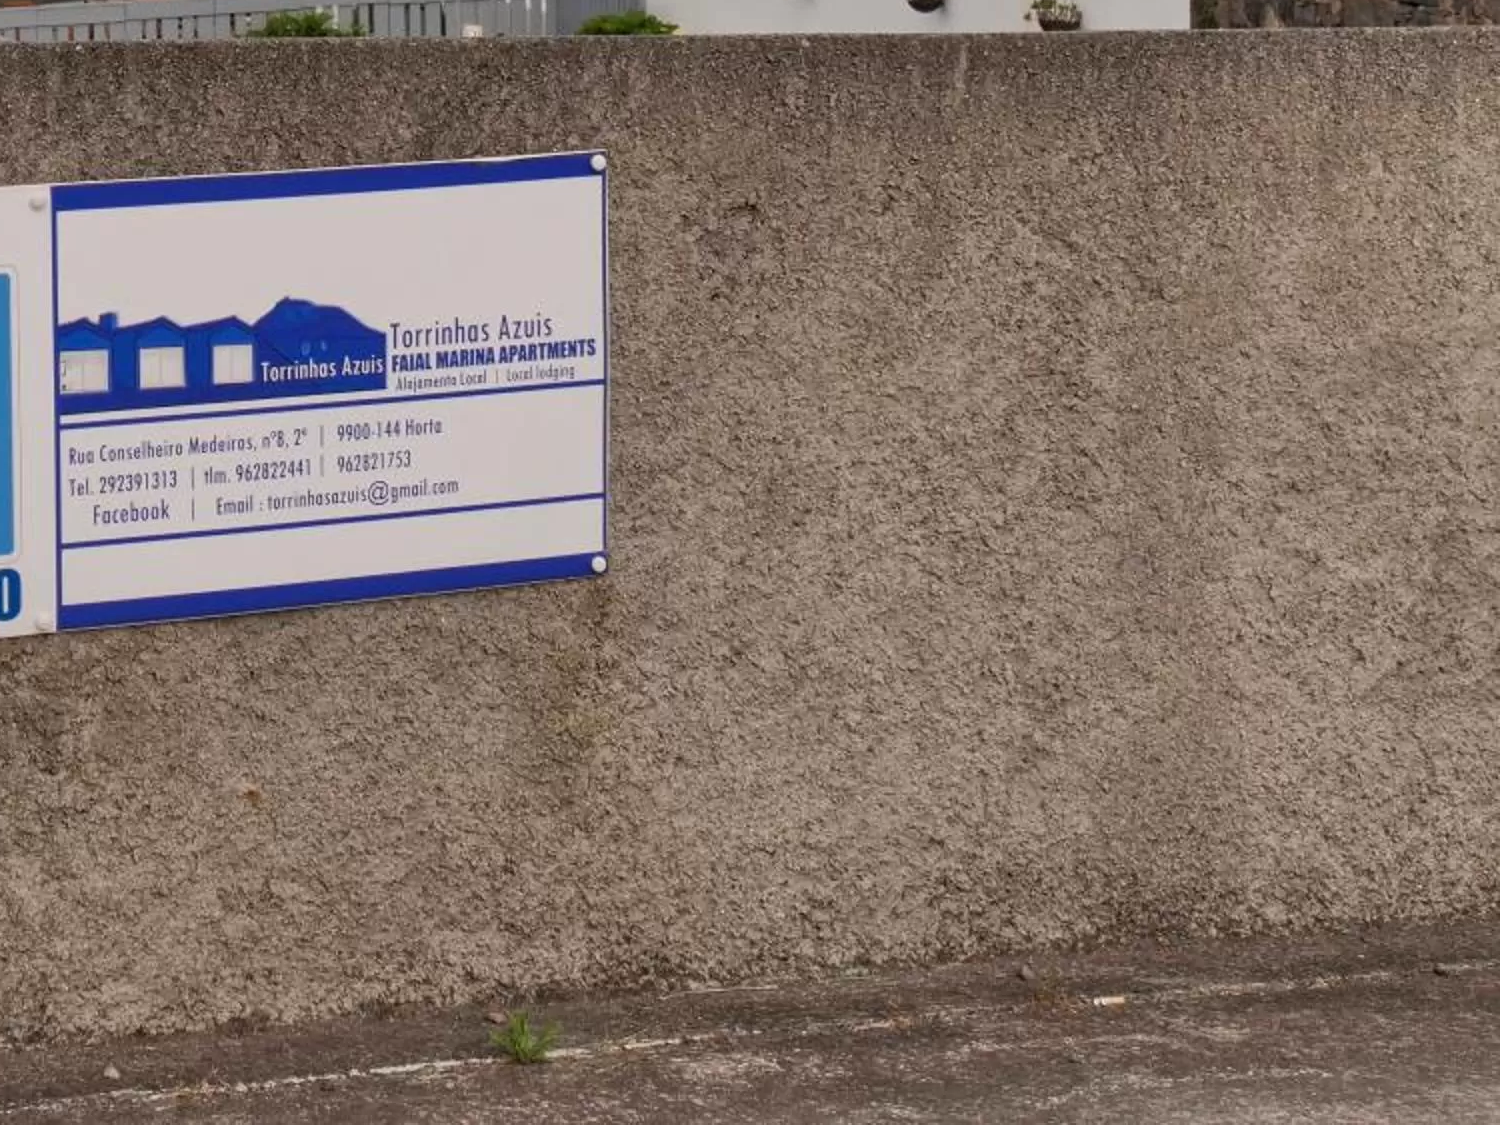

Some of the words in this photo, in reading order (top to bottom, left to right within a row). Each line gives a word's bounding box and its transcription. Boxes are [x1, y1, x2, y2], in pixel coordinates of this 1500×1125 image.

[389, 316, 489, 350] Torrinhas
[499, 312, 554, 341] Azuis
[260, 357, 336, 383] Torrinhas
[341, 353, 386, 378] Azuis
[391, 351, 433, 374] FAIAL
[436, 346, 496, 370] MARINA
[499, 338, 597, 365] APARTMENTS
[459, 370, 487, 386] Local
[507, 365, 533, 382] Local
[68, 447, 95, 466] Rua
[99, 440, 184, 463] Conselheiro
[187, 434, 258, 456] Medeiros,
[336, 420, 401, 442] 9900-144
[405, 418, 443, 437] Horta
[68, 477, 95, 496] Tel.
[99, 470, 178, 495] 292391313
[235, 459, 312, 483] 962822441
[336, 450, 412, 474] 962821753
[92, 499, 171, 526] Facebook
[216, 495, 254, 516] Email
[267, 479, 460, 512] torrinhasazuis@gmail.com
